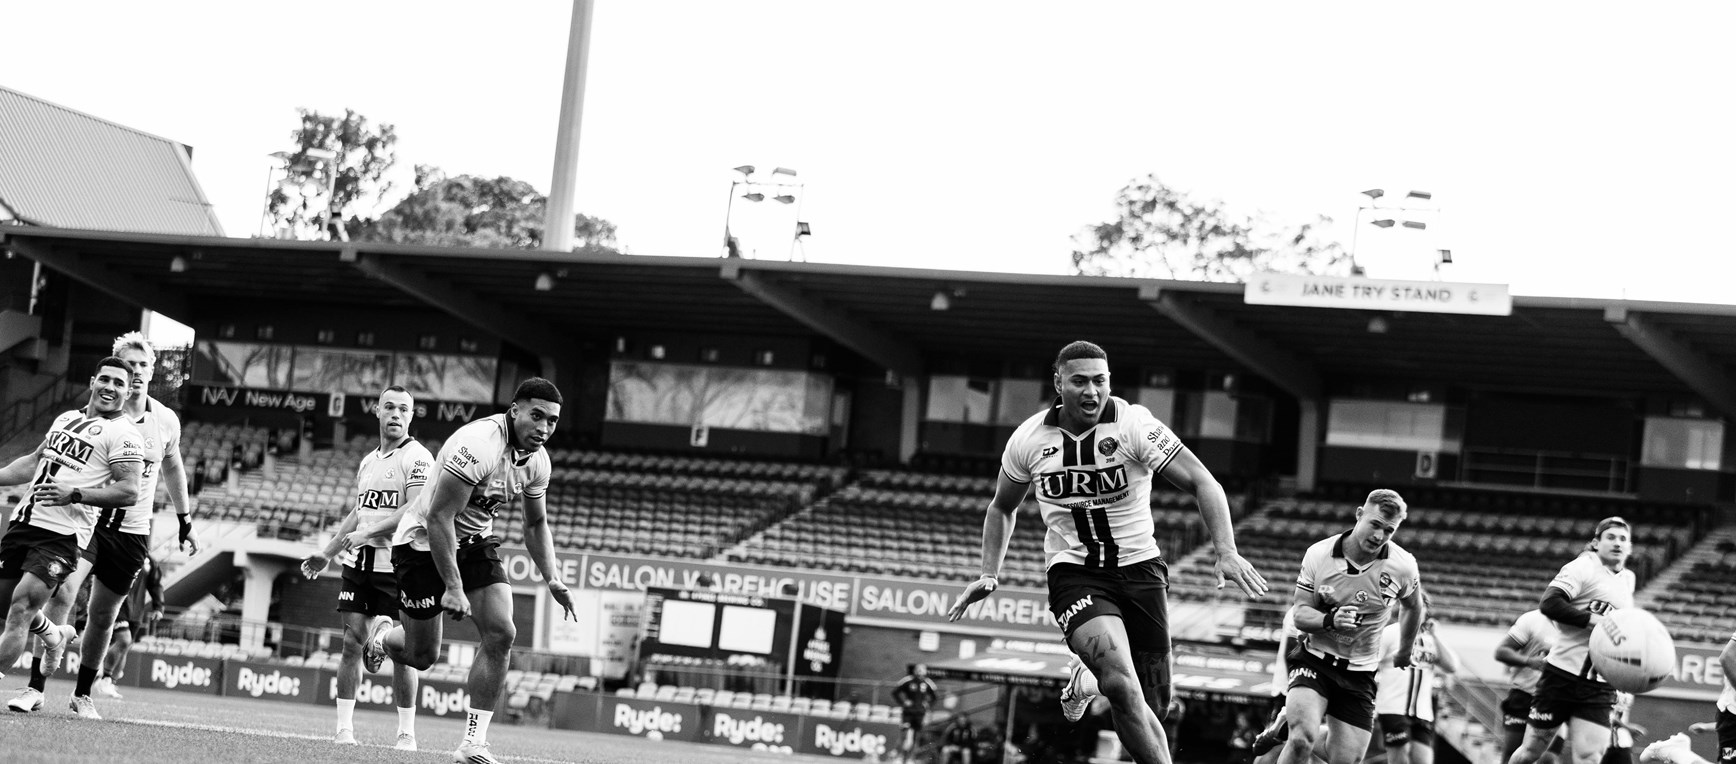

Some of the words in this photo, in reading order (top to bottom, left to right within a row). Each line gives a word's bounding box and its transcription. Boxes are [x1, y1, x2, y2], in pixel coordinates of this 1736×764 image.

[1302, 284, 1345, 298] JANE
[1353, 284, 1385, 297] TRY
[1391, 287, 1452, 303] STAND
[245, 391, 282, 408] New
[283, 393, 316, 412] Age
[458, 446, 479, 466] Shaw
[1157, 434, 1171, 451] and
[452, 454, 468, 469] and
[1043, 468, 1128, 498] URM
[1092, 491, 1130, 506] MANAGEMENT
[589, 561, 675, 591] SALON
[861, 585, 949, 617] SALON
[956, 594, 1060, 628] AREH
[151, 659, 211, 688] Ryde:
[237, 667, 300, 697] Ryde:
[329, 676, 394, 705] de:
[613, 703, 683, 734] Ryde:
[713, 713, 785, 744] Ryde:
[815, 724, 887, 756] Ryde:
